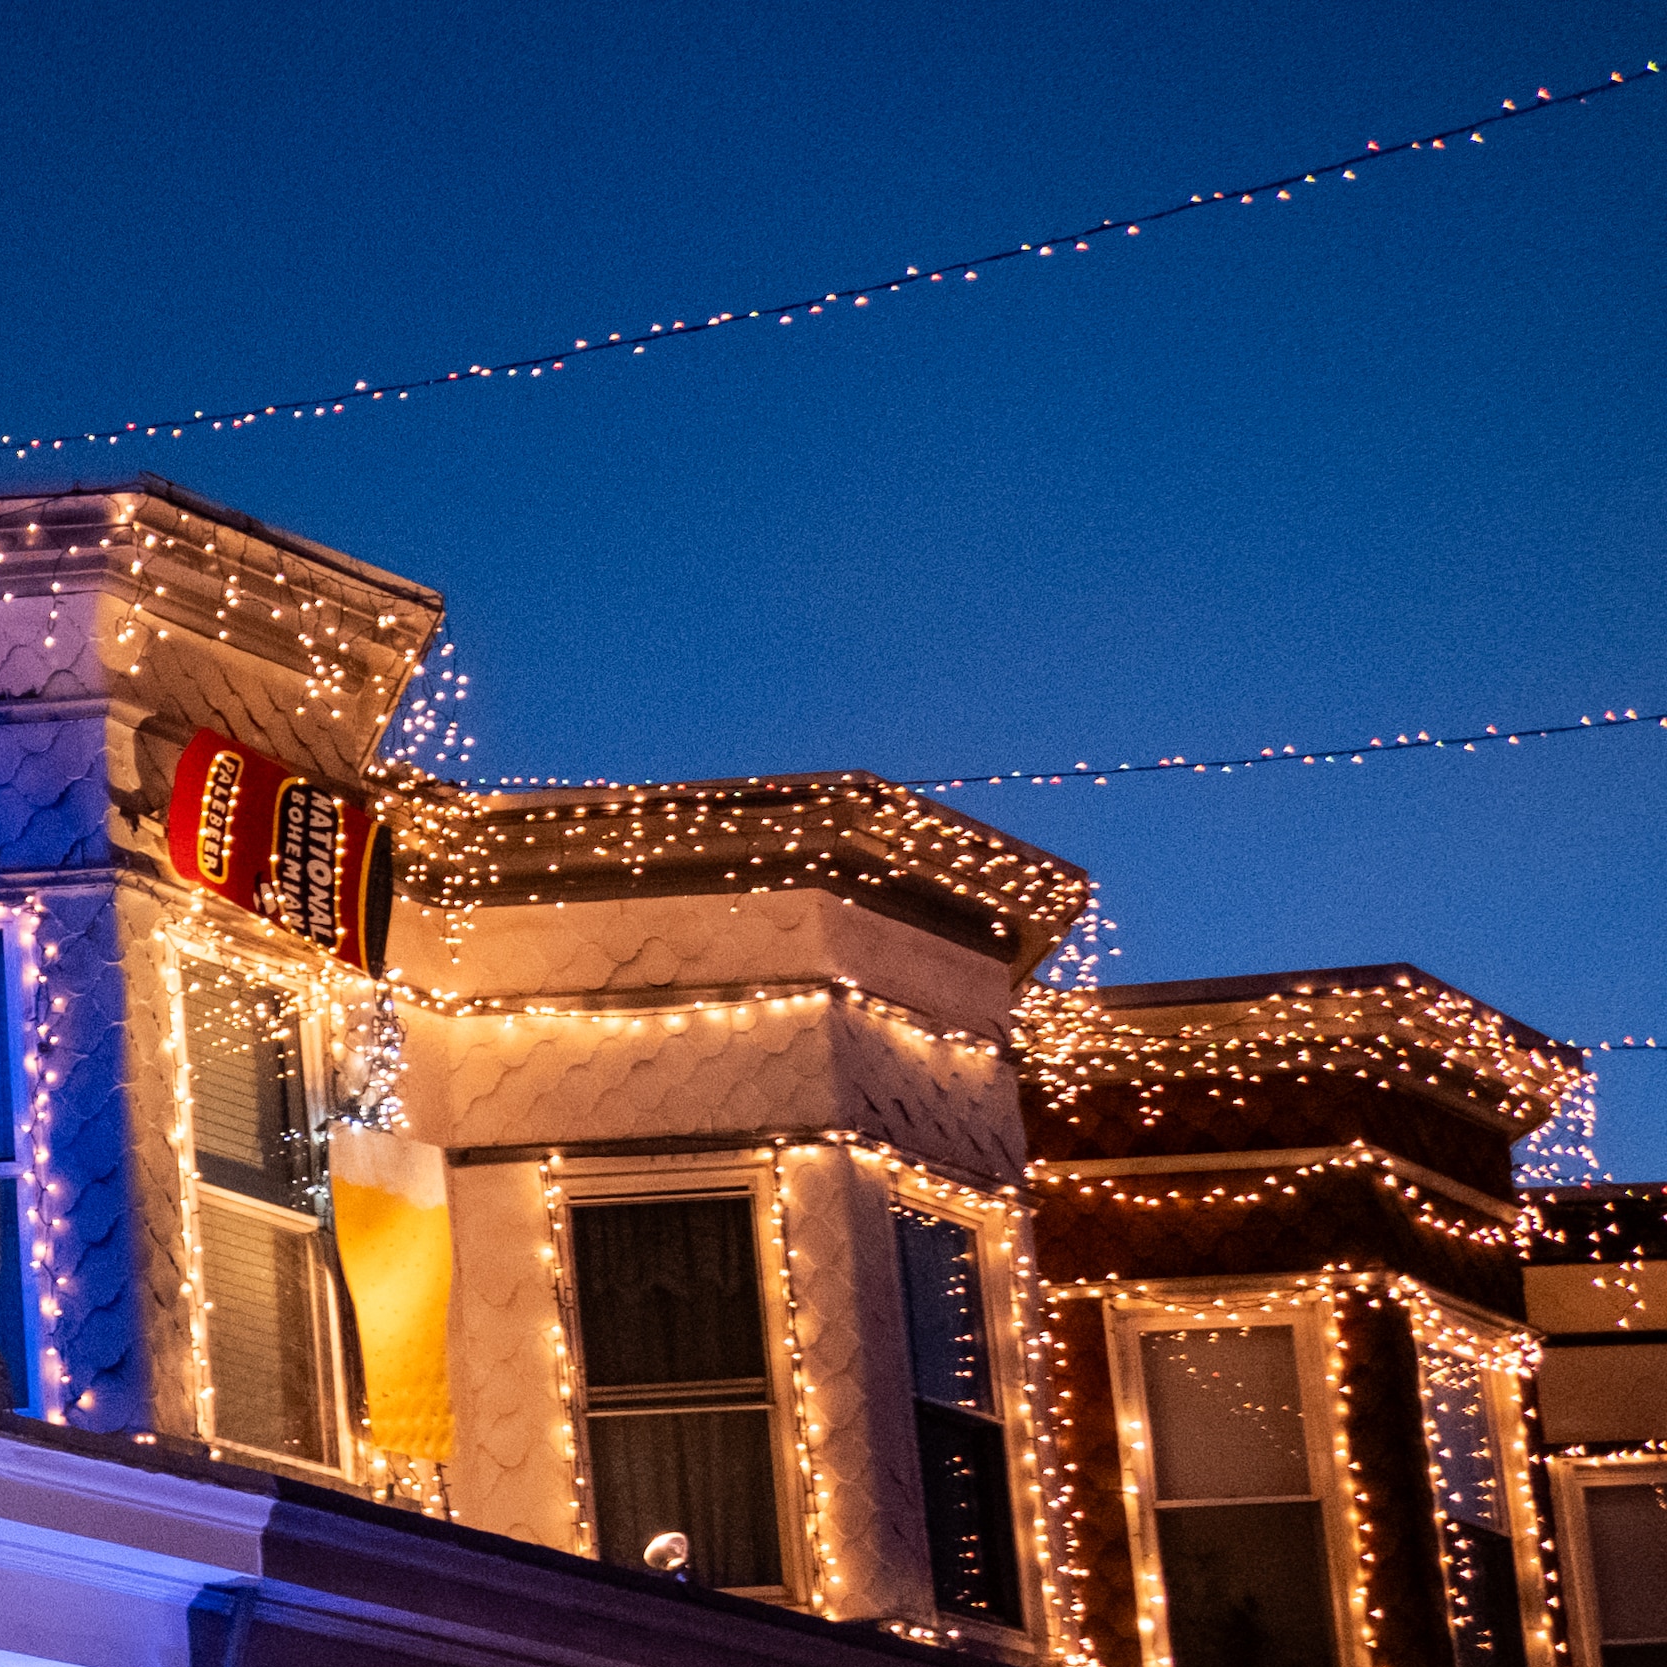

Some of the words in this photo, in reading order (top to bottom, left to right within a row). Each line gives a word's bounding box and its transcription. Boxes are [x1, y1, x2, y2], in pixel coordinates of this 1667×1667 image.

[211, 760, 235, 815] PALE
[203, 813, 223, 869] BEER
[282, 790, 306, 929] BOHEMIAN
[306, 790, 333, 942] NATIONAL
